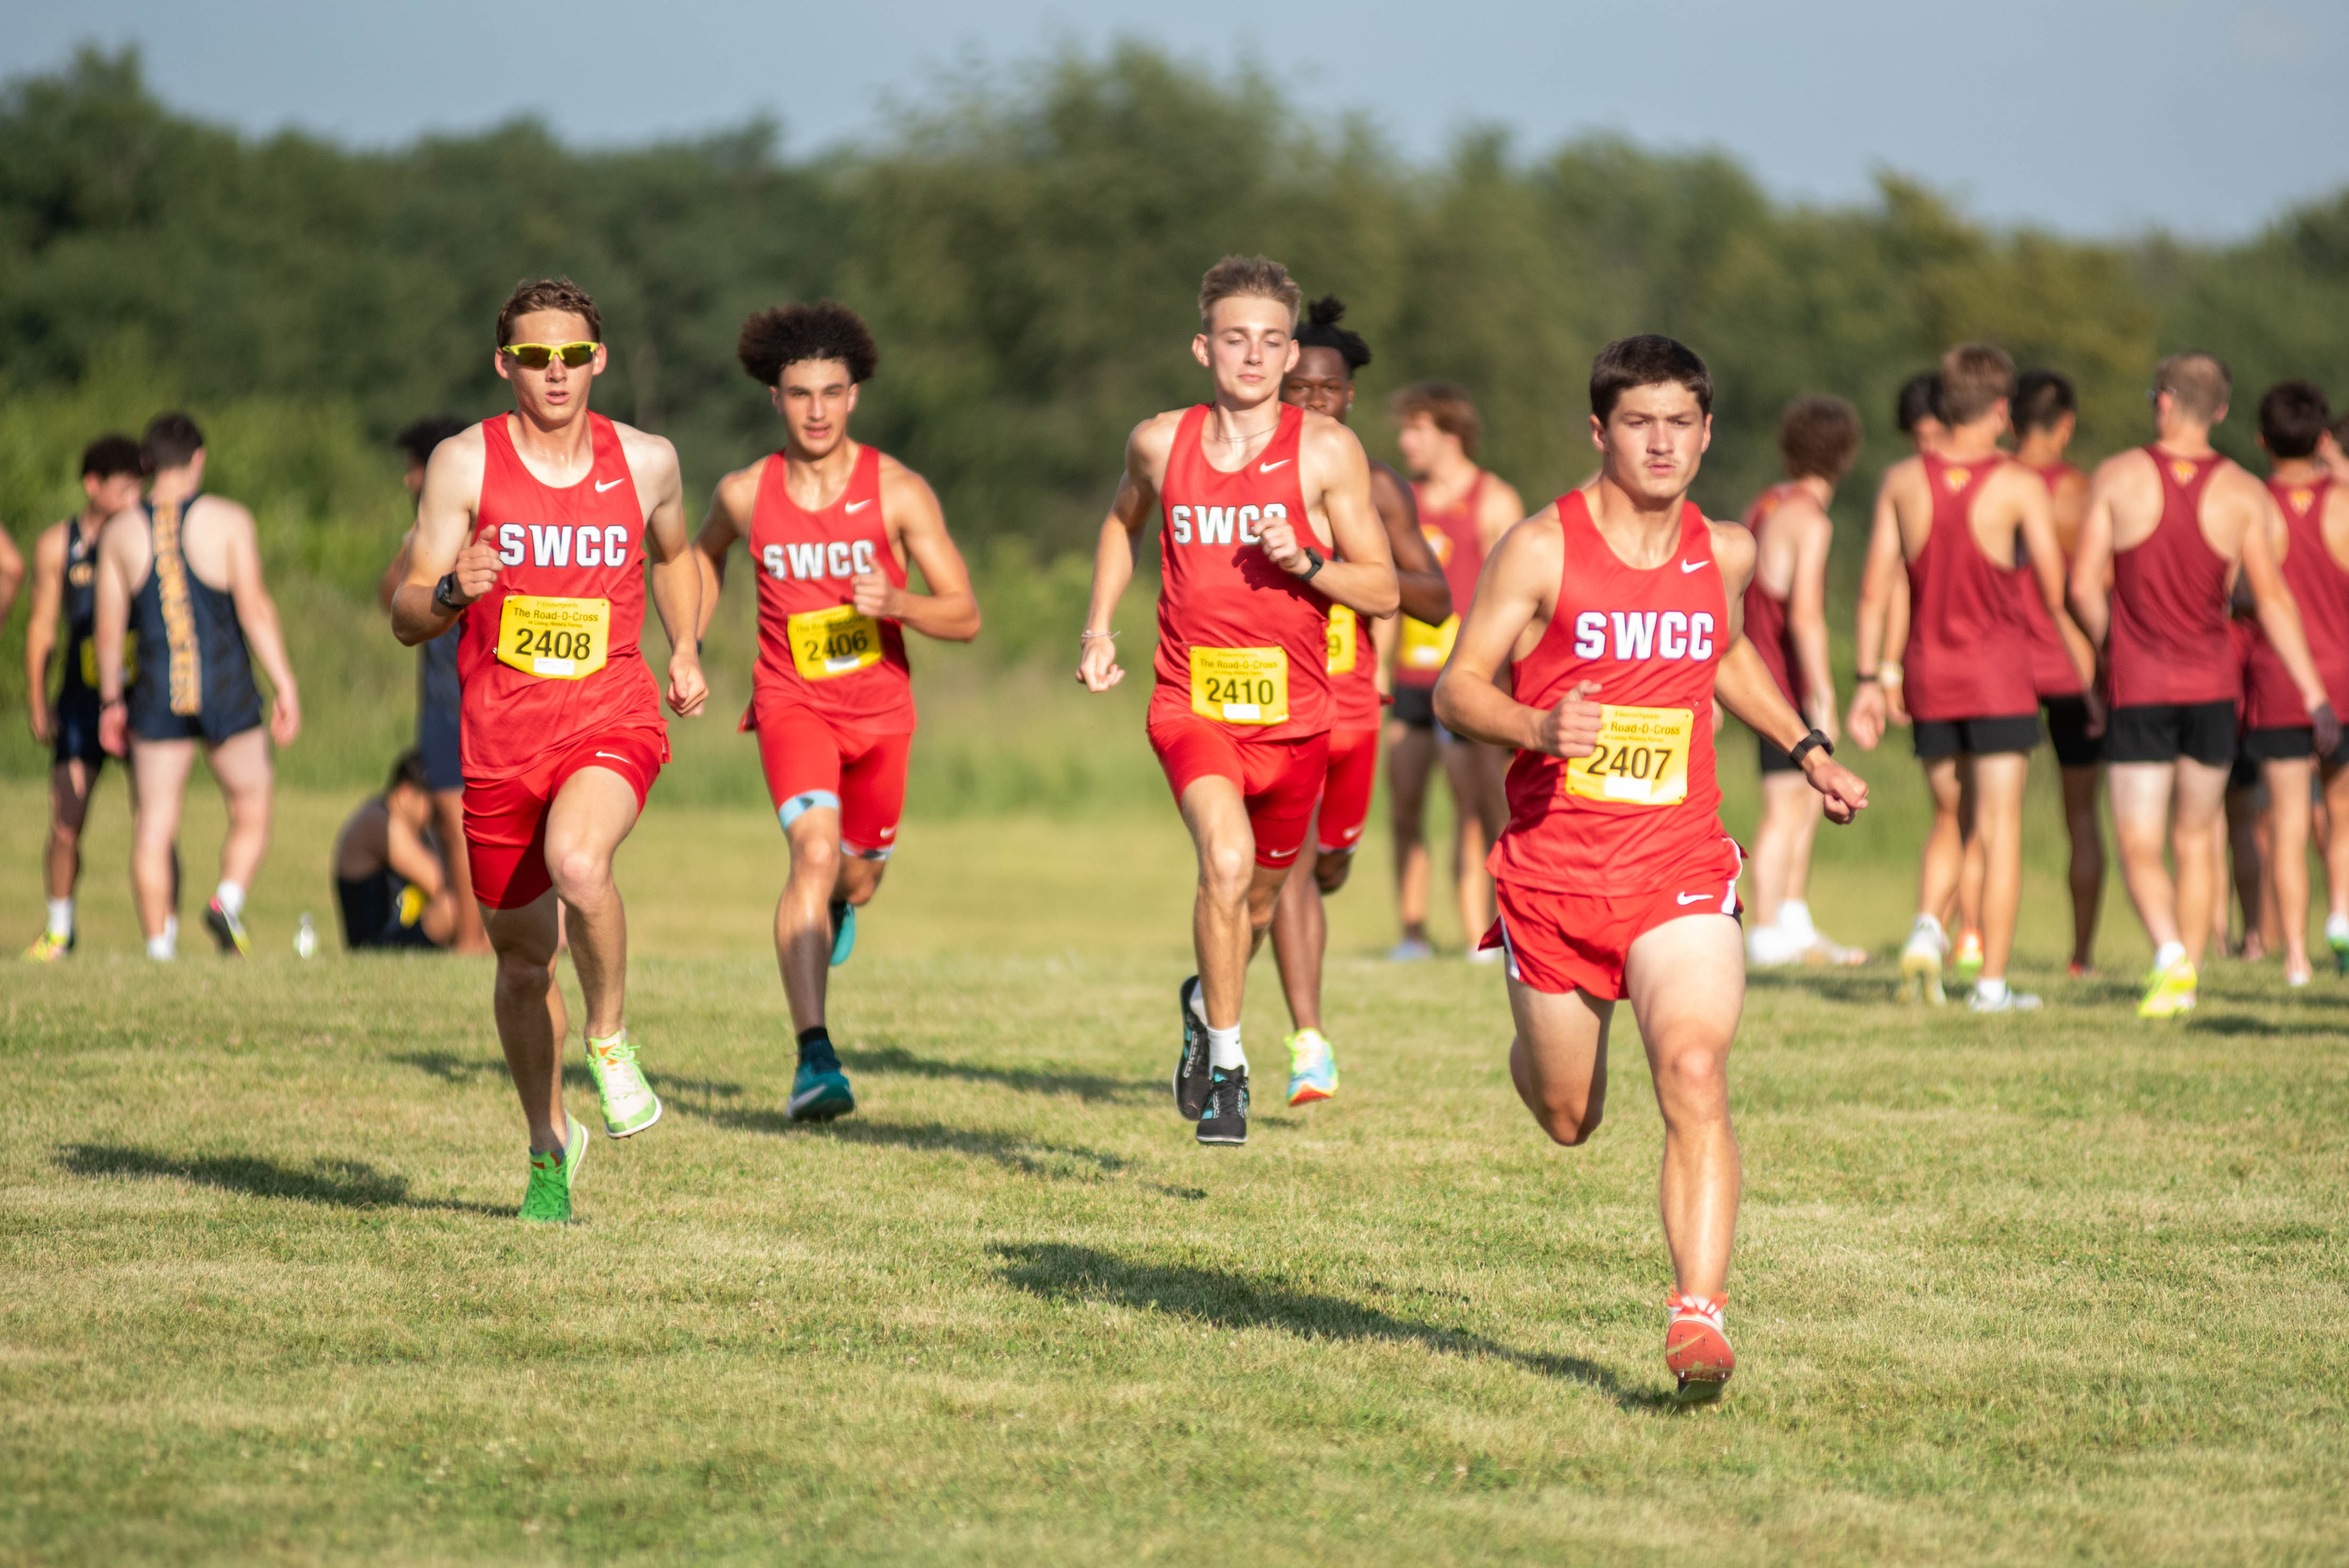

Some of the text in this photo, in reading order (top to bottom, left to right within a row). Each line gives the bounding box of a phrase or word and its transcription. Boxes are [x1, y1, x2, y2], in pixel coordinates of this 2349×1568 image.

[499, 523, 629, 568] SWCC
[763, 538, 874, 581] SWCC
[514, 607, 599, 622] The Road-O-Cross
[515, 627, 591, 661] 2408
[804, 630, 868, 662] 2406
[1574, 610, 1715, 662] SWCC
[1200, 658, 1215, 668] The
[1206, 677, 1275, 706] 2410
[1611, 721, 1681, 736] Road-O-Cross
[1587, 744, 1673, 780] 2407
